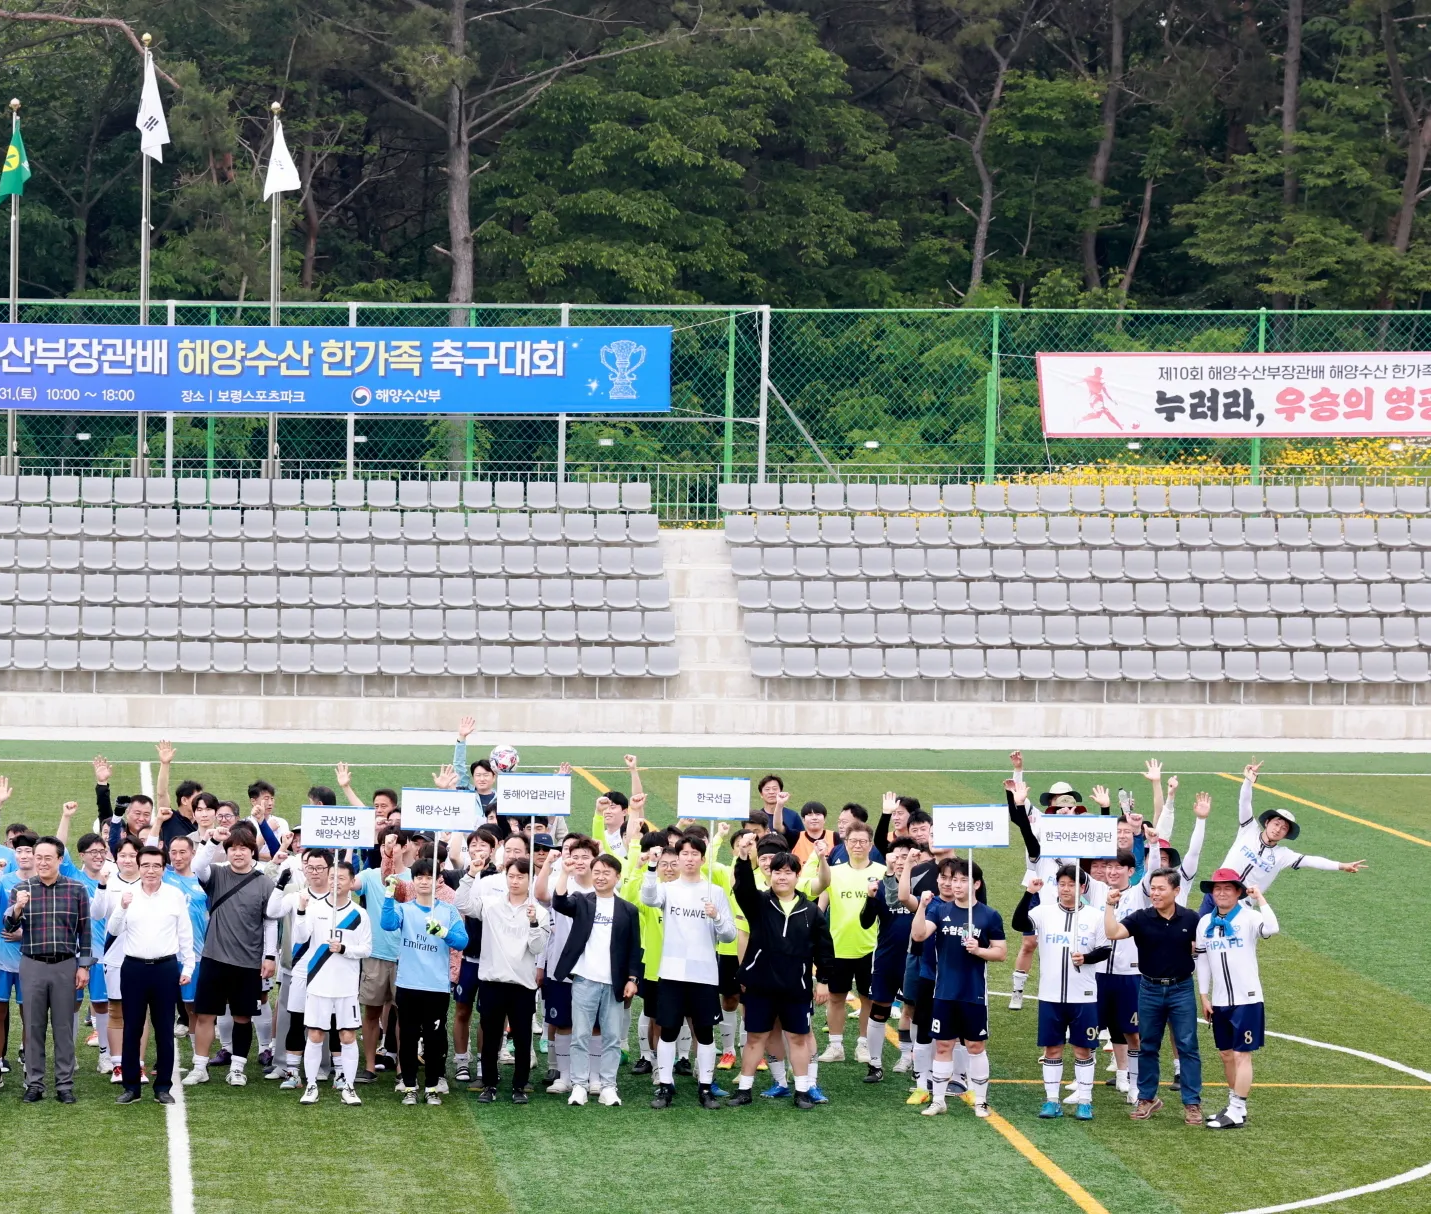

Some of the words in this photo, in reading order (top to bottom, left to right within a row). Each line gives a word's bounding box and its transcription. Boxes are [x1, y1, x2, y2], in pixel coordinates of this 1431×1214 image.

[177, 339, 314, 376] 해양수산
[320, 339, 423, 377] 한가족
[430, 339, 564, 377] 축구대회
[1158, 366, 1203, 381] 제10회
[1208, 365, 1325, 380] 해양수산부장관배
[1330, 365, 1388, 380] 해양수산
[0, 387, 37, 401] 31.(토)
[46, 389, 80, 401] 10:00
[101, 389, 135, 401] 18:00
[181, 390, 205, 403] 장소
[217, 390, 305, 403] 보령스포츠파크
[375, 389, 442, 403] 해양수산부
[1154, 387, 1265, 427] 누려라,
[1274, 386, 1375, 422] 우승의
[503, 789, 565, 801] 동해어업관리단
[696, 792, 732, 804] 한국선급
[416, 804, 461, 816] 해양수산부
[320, 815, 356, 827] 군산지방
[948, 821, 994, 832] 수협중앙회
[315, 828, 360, 840] 해양수산청
[1045, 831, 1113, 843] 한국어촌어항공단
[670, 906, 680, 916] FC
[416, 933, 427, 942] Fly
[403, 938, 438, 953] Emirates
[1243, 1030, 1253, 1044] 8
